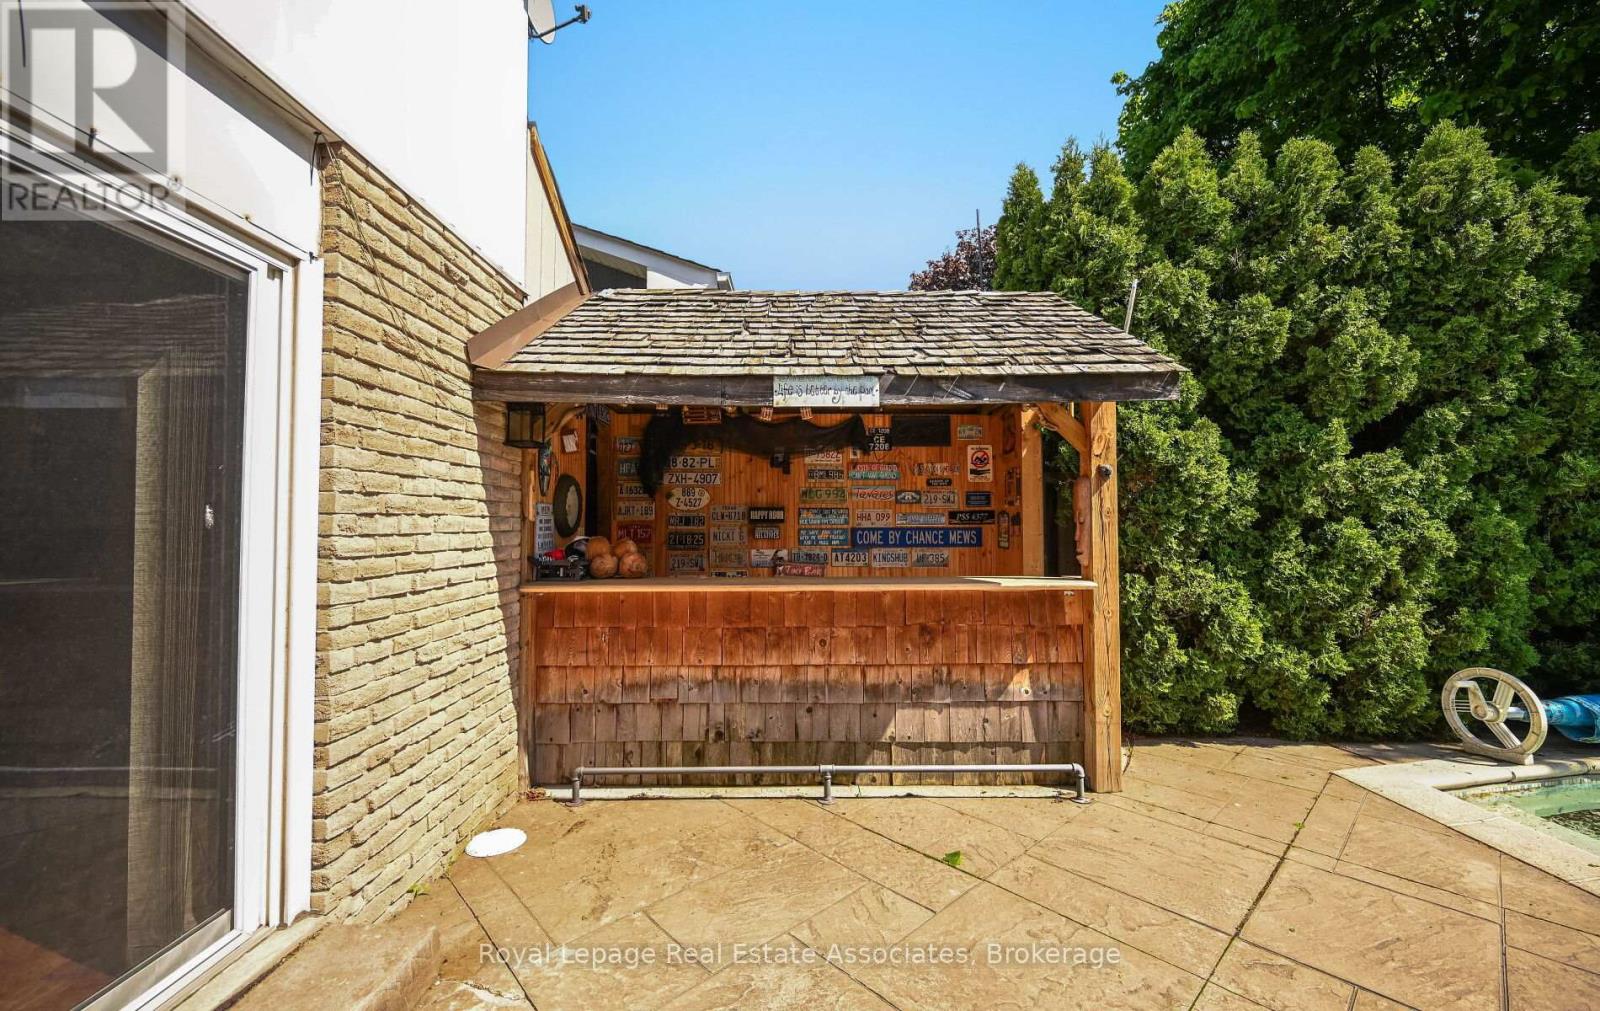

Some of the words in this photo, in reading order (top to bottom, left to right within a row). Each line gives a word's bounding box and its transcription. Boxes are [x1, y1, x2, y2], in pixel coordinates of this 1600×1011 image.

[668, 473, 719, 484] ZXH-4907
[856, 512, 872, 522] HHA
[875, 512, 891, 522] 099
[856, 530, 884, 545] COME
[888, 530, 900, 545] BY
[905, 530, 945, 545] CHANCE
[949, 530, 977, 545] MEWS
[833, 552, 868, 563] AT4203
